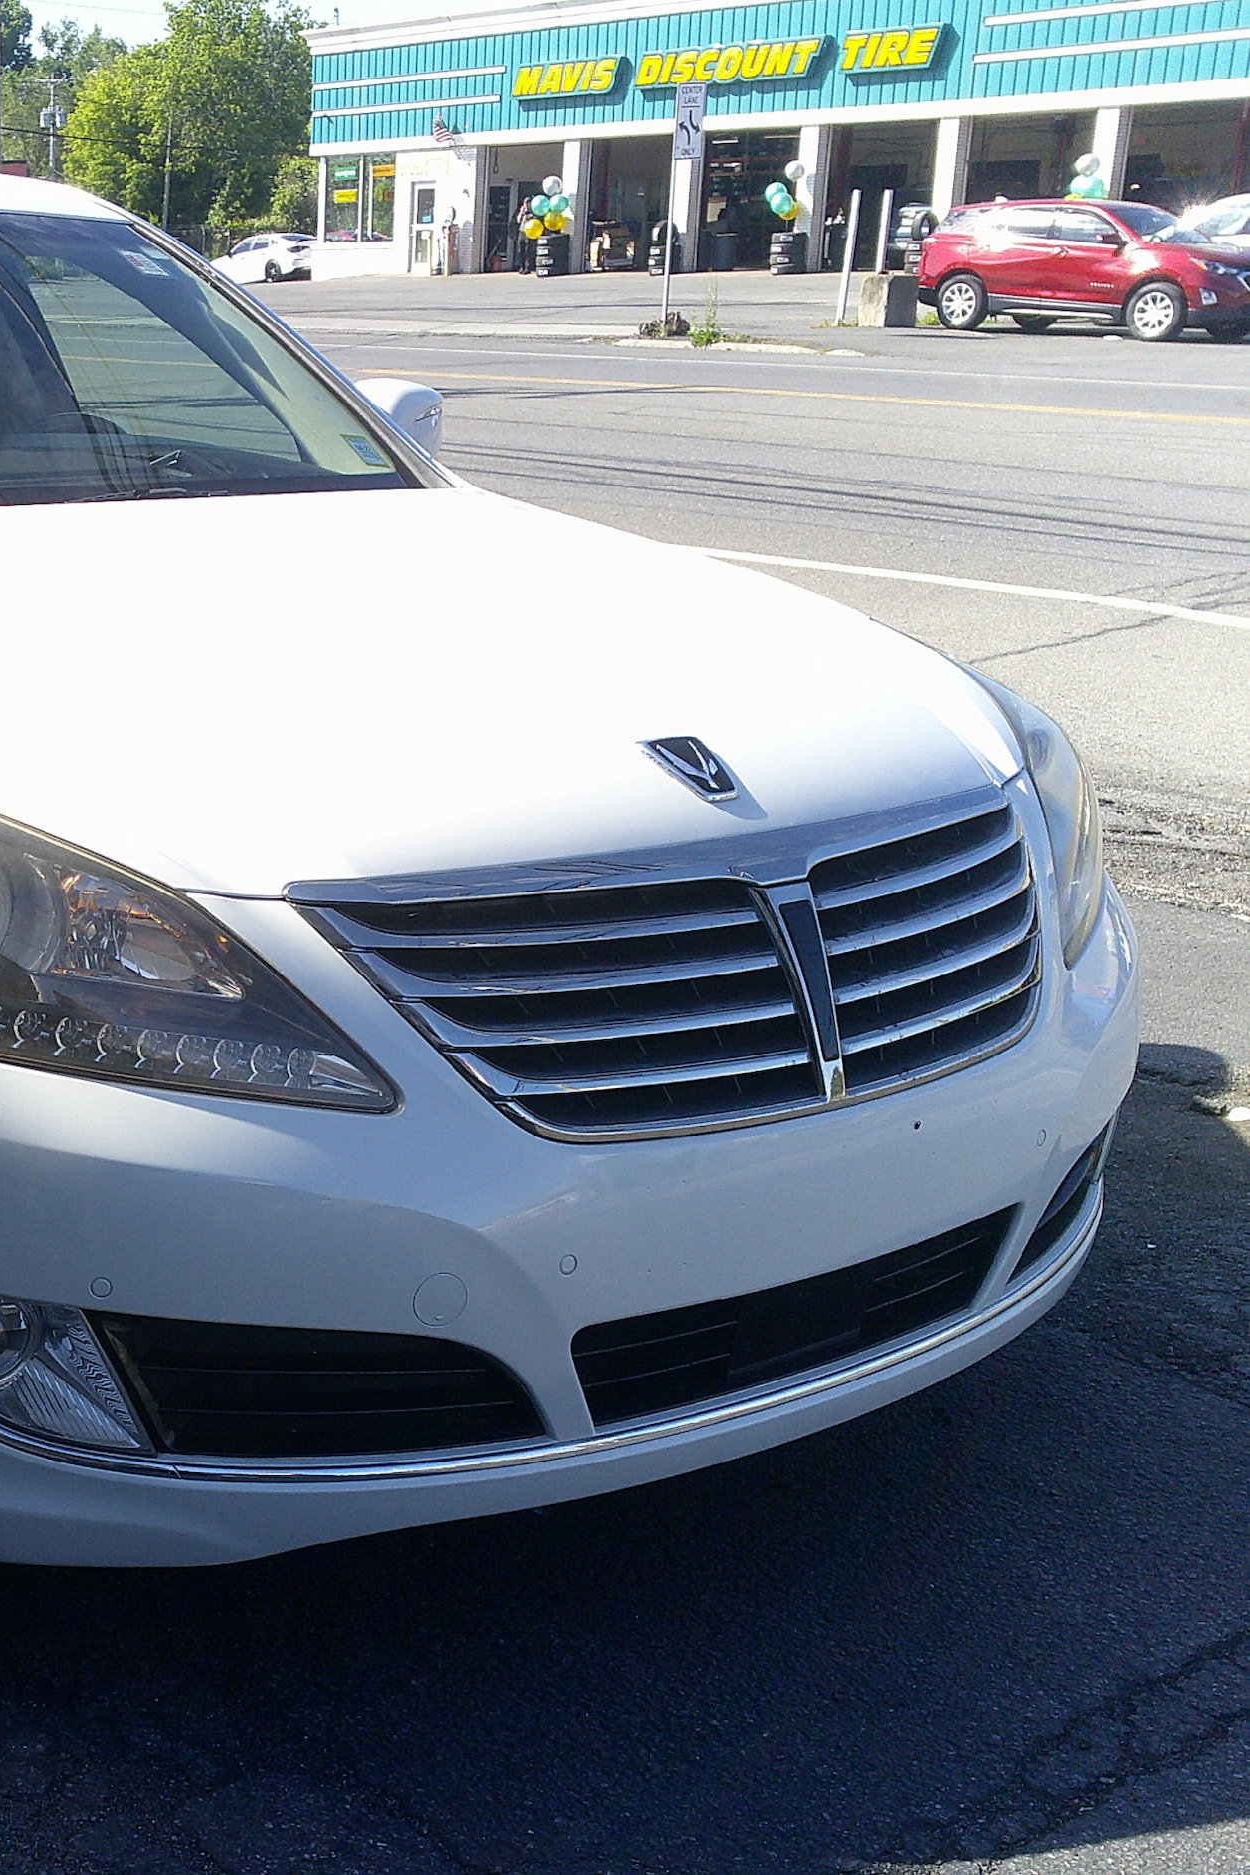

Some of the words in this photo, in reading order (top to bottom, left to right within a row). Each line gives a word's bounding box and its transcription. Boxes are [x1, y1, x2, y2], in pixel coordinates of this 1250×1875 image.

[513, 59, 617, 97] MAVIS
[635, 39, 820, 86] DISCOUNT
[841, 28, 939, 70] TIRE
[681, 85, 702, 94] CENTER
[684, 96, 699, 104] LANE
